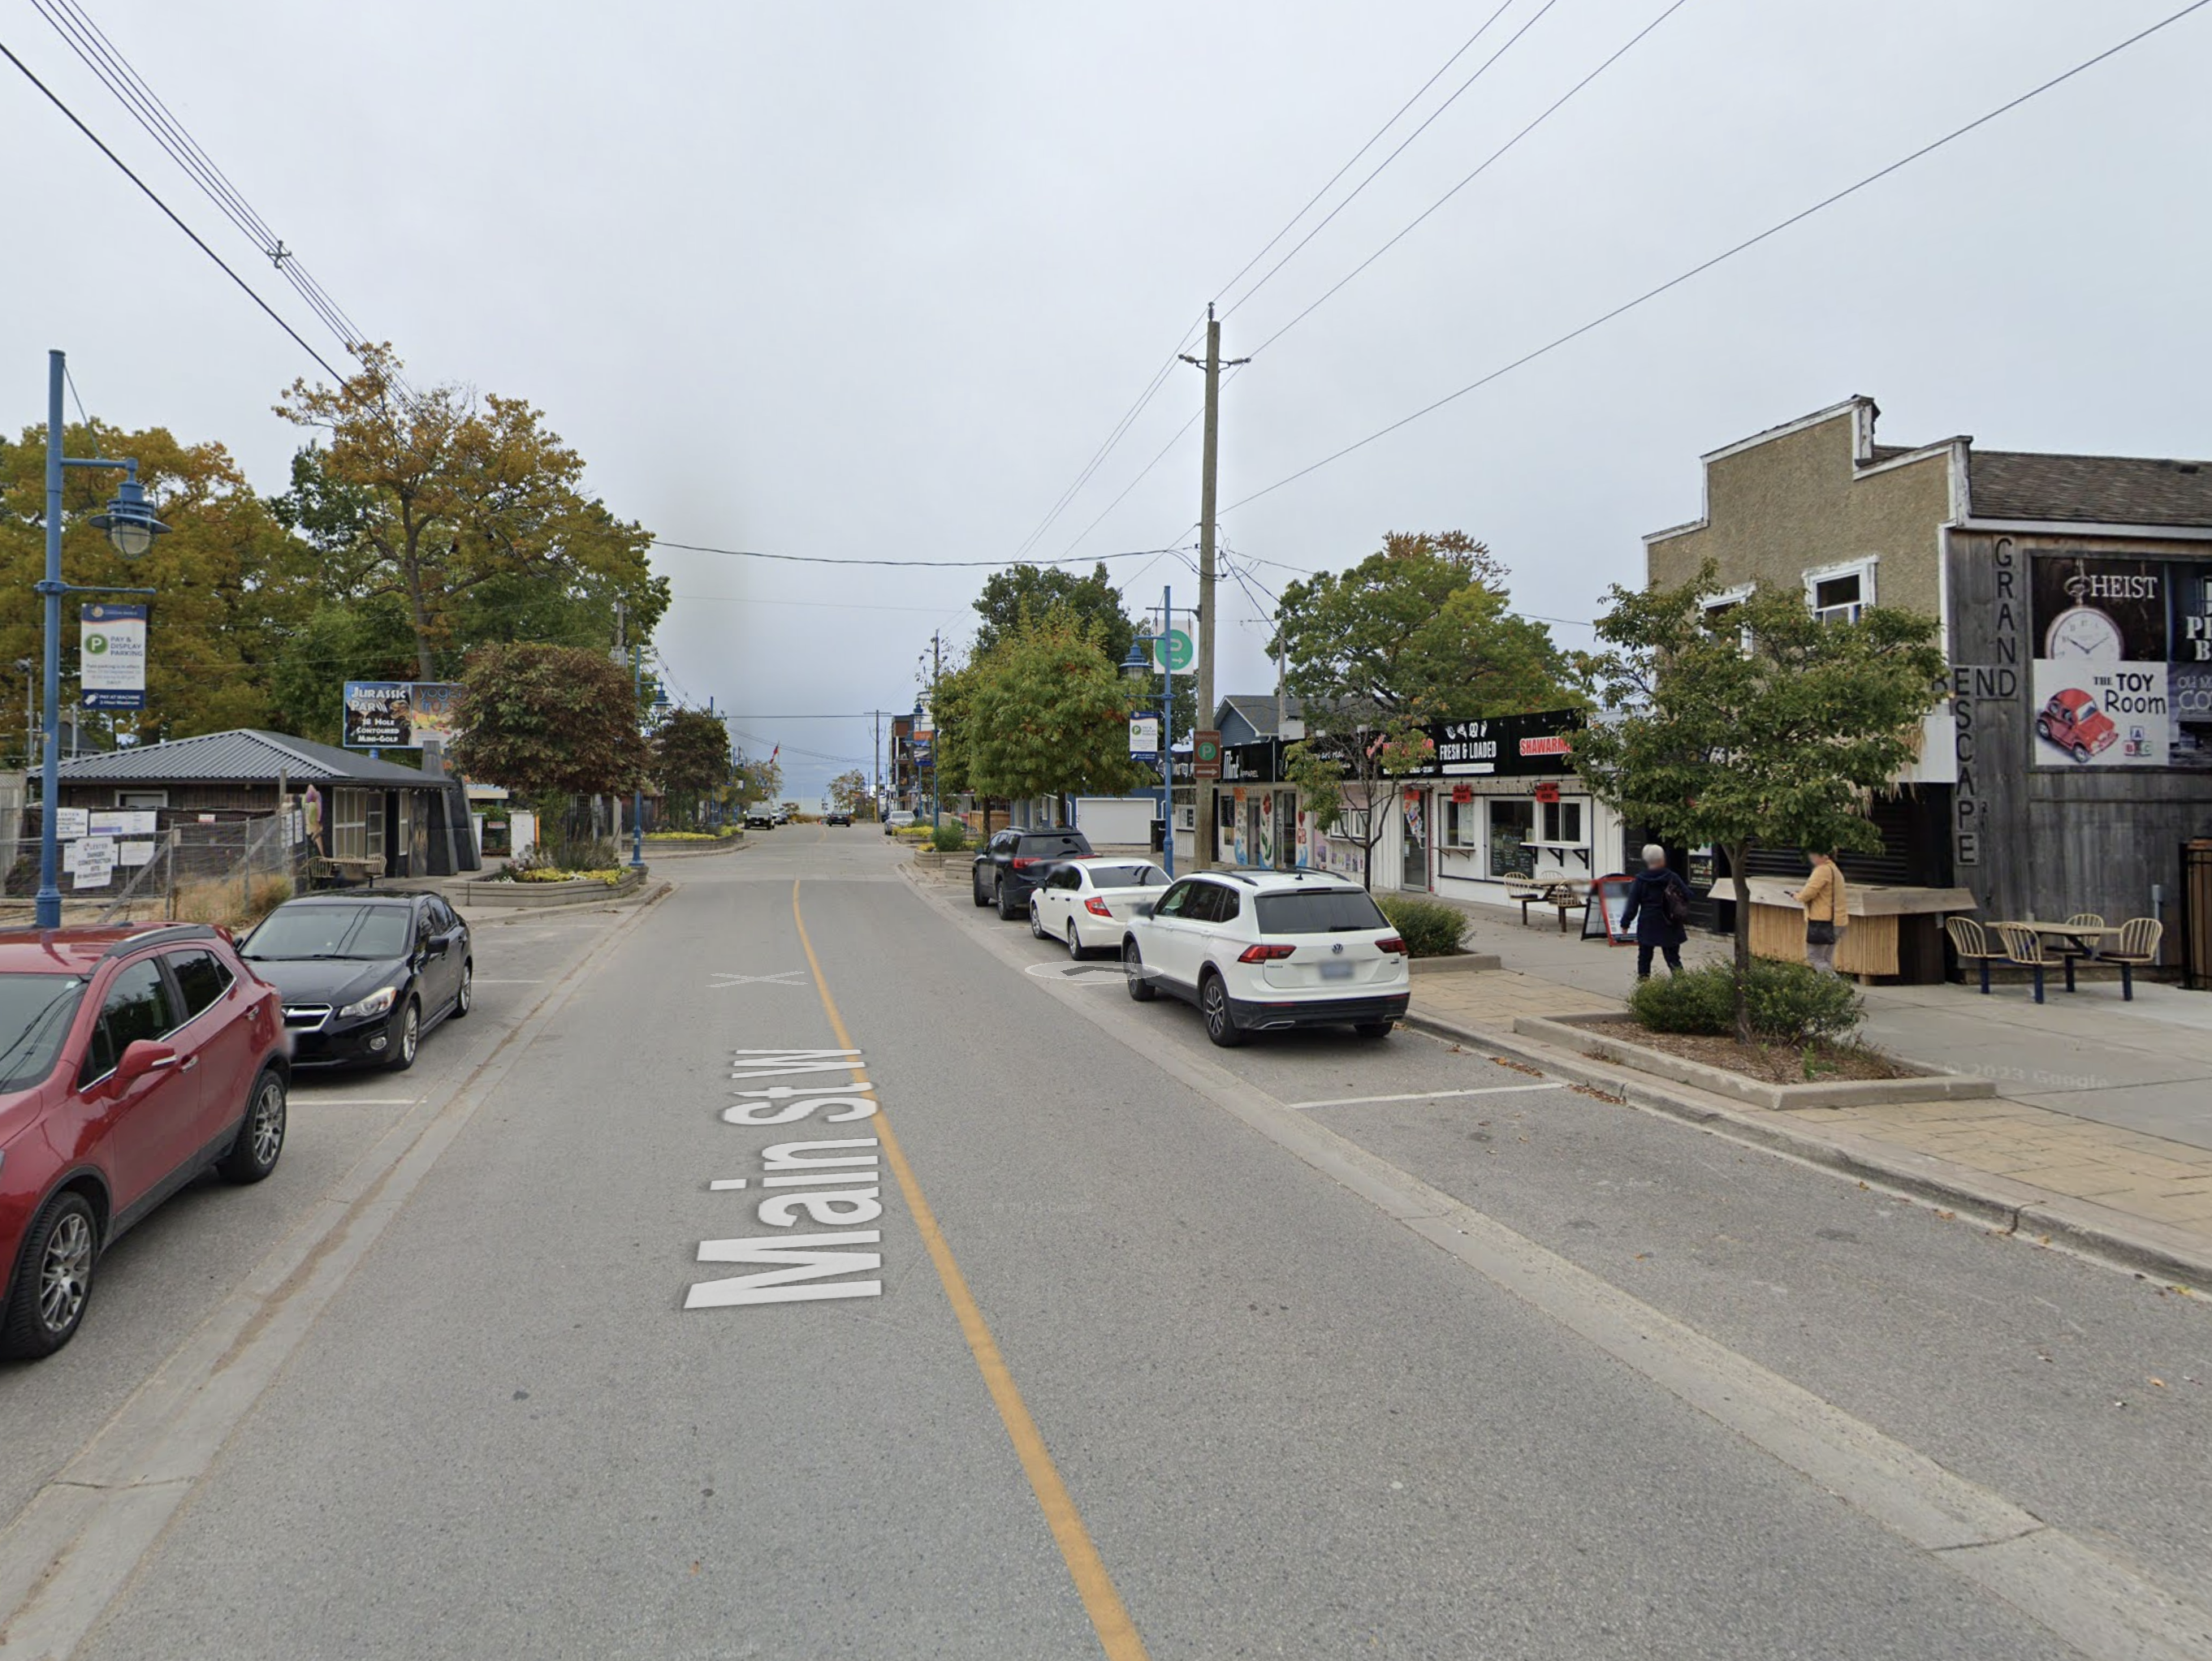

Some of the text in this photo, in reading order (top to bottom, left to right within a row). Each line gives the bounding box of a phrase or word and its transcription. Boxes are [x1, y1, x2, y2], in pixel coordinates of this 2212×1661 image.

[2089, 575, 2158, 598] HEIST
[1995, 537, 2017, 697] GRAND
[91, 637, 102, 651] P
[2093, 673, 2154, 692] THE TOY
[2105, 689, 2167, 714] Room
[1440, 744, 1461, 761] FRESH
[1462, 743, 1468, 760] &
[1469, 740, 1497, 759] LOADED
[1954, 667, 1975, 864] ESCAPE
